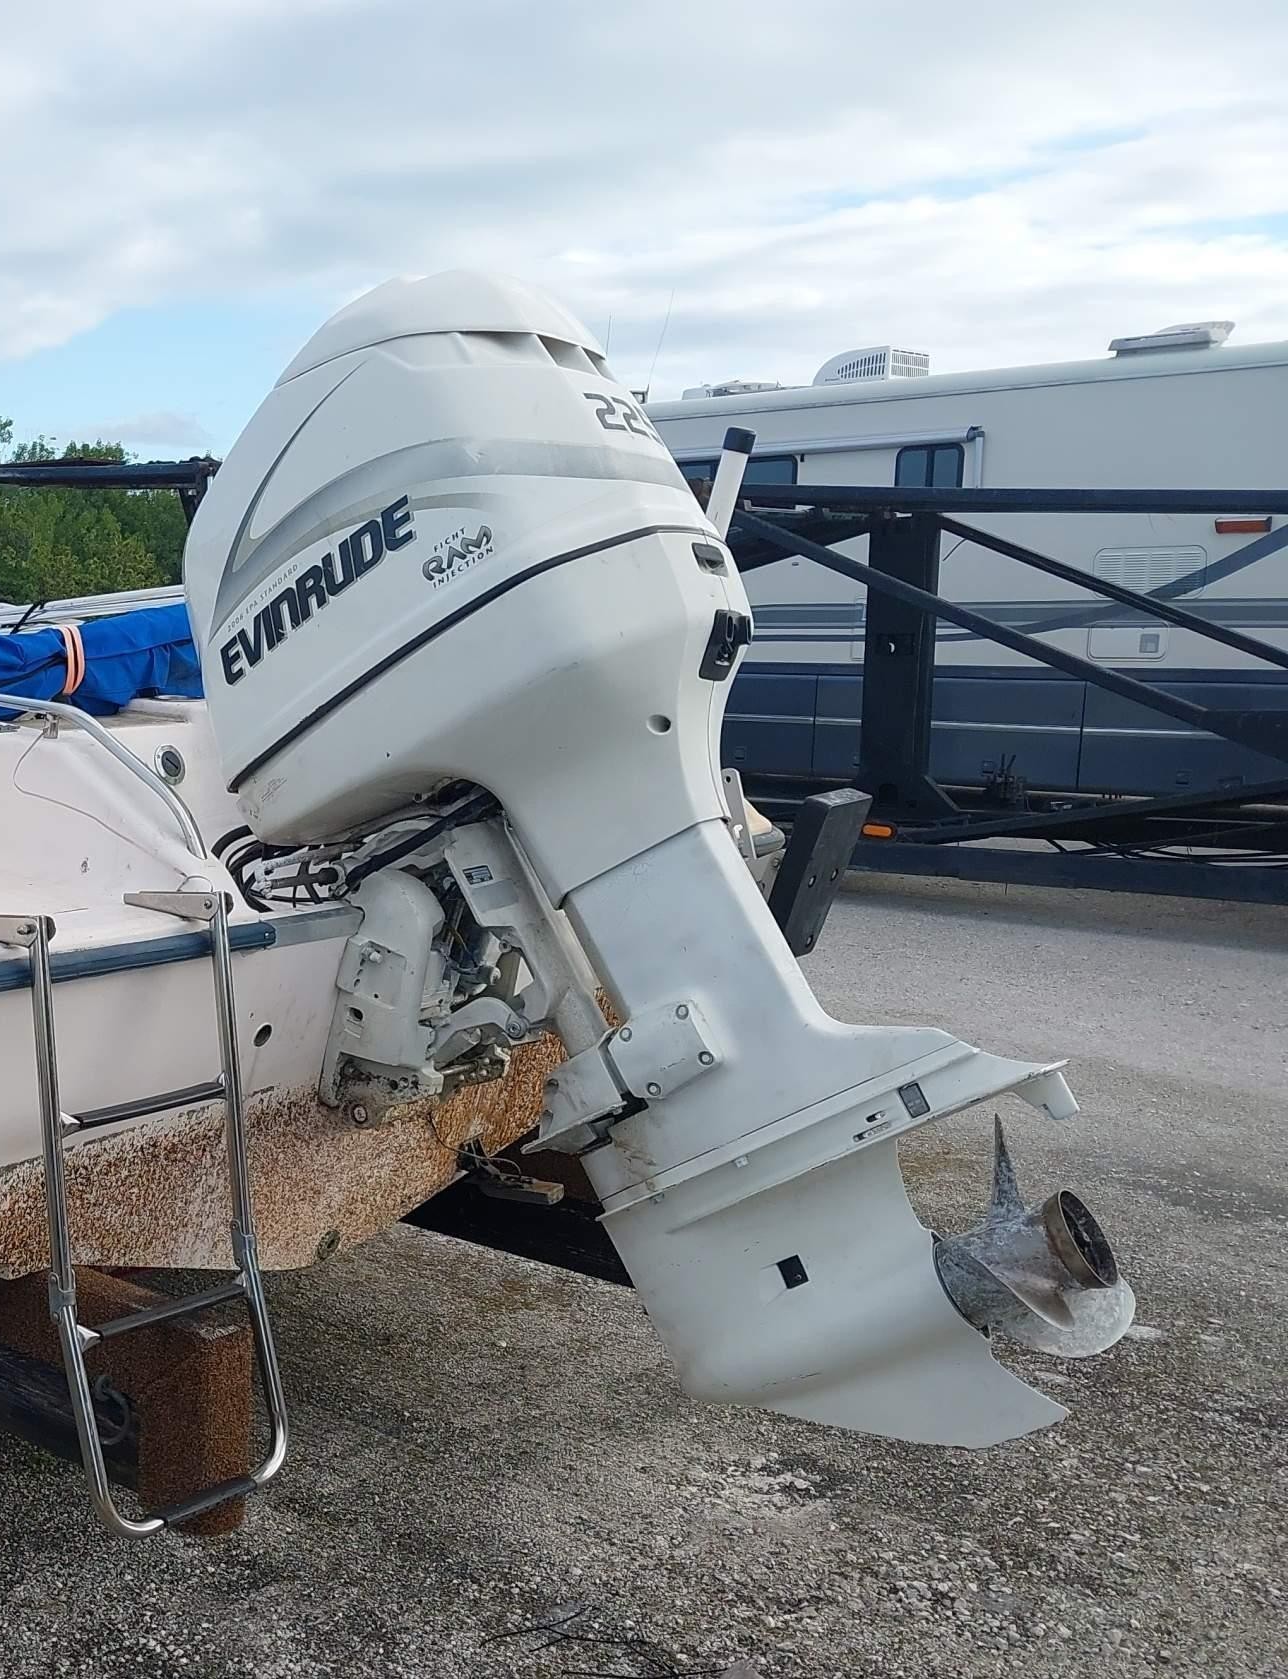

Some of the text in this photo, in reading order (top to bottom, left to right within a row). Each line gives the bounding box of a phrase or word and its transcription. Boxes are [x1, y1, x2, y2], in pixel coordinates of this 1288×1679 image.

[422, 525, 492, 581] RAM
[434, 527, 465, 552] FICHT
[259, 564, 298, 601] STANDARD
[433, 546, 493, 589] INJECTION
[220, 494, 416, 686] EVINRUDE
